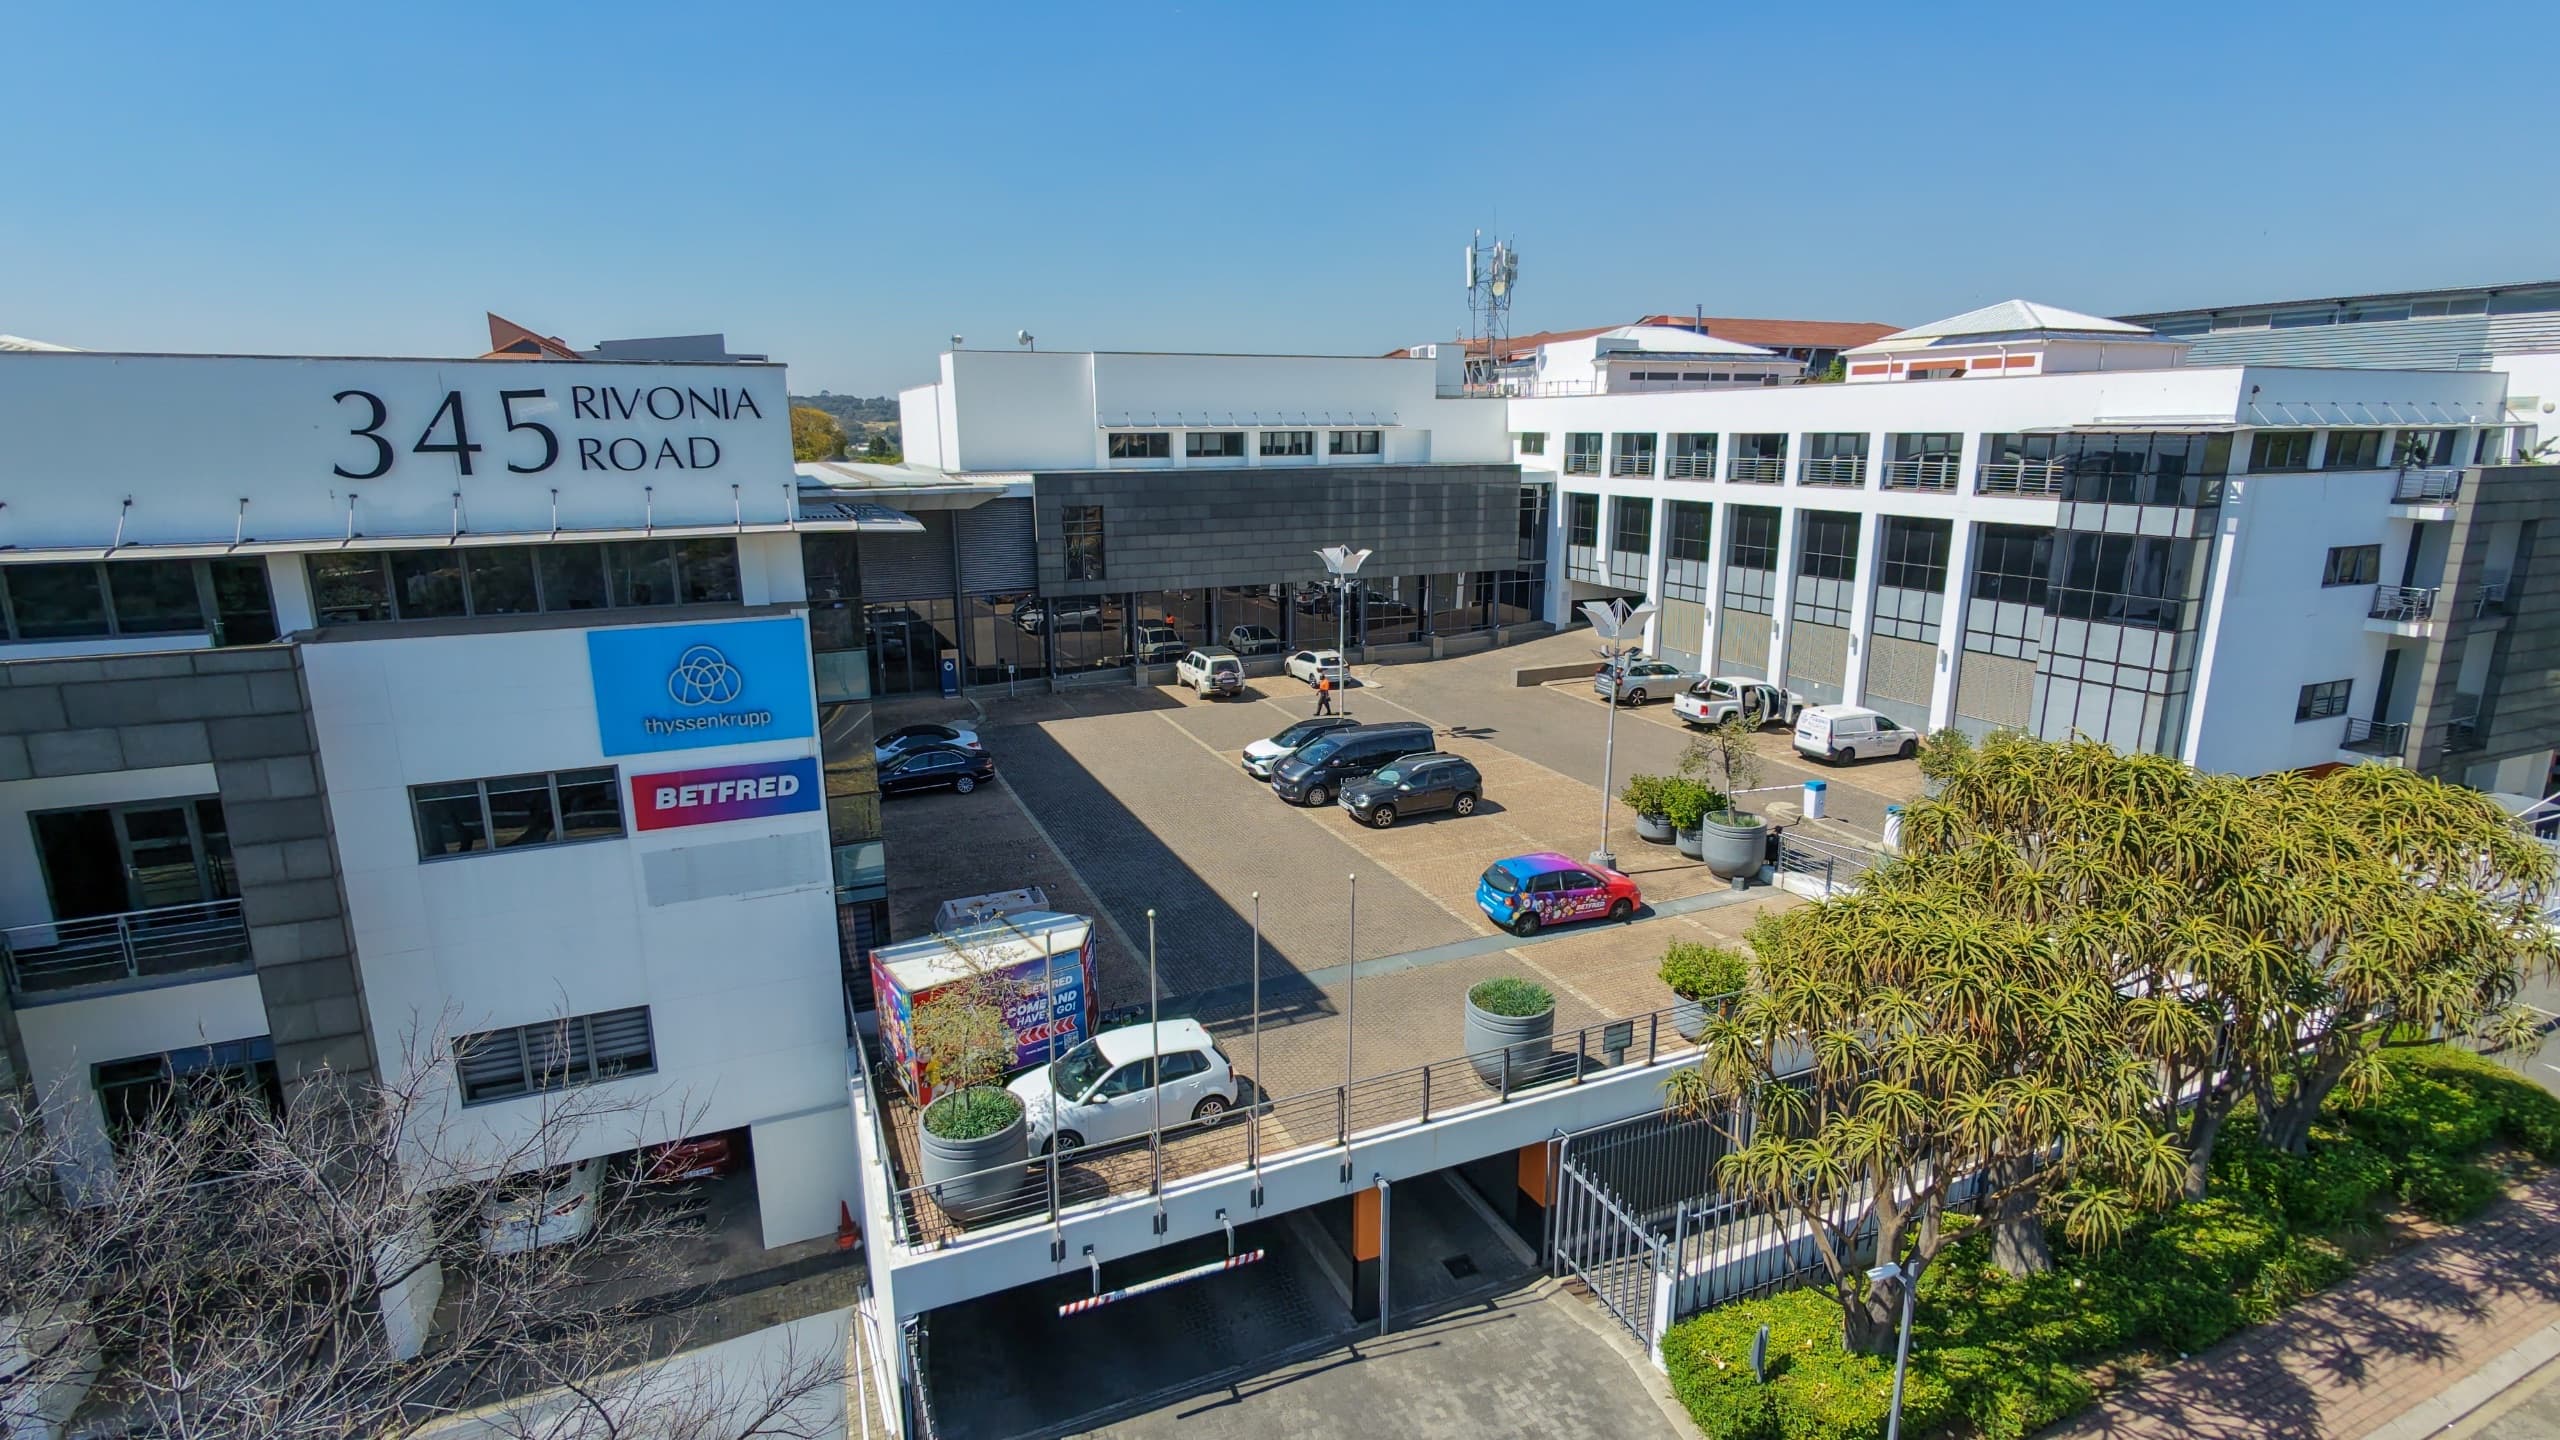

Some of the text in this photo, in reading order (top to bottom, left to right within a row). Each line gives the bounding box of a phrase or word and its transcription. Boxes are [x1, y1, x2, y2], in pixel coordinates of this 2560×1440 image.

[571, 385, 762, 420] RIVONIA
[333, 388, 559, 479] 345
[578, 436, 721, 471] ROAD
[644, 711, 772, 736] thyssenkrupp
[655, 774, 800, 811] BETFRED
[1006, 998, 1047, 1019] COME
[1016, 1009, 1045, 1027] HAVE
[1056, 1001, 1076, 1015] GO!
